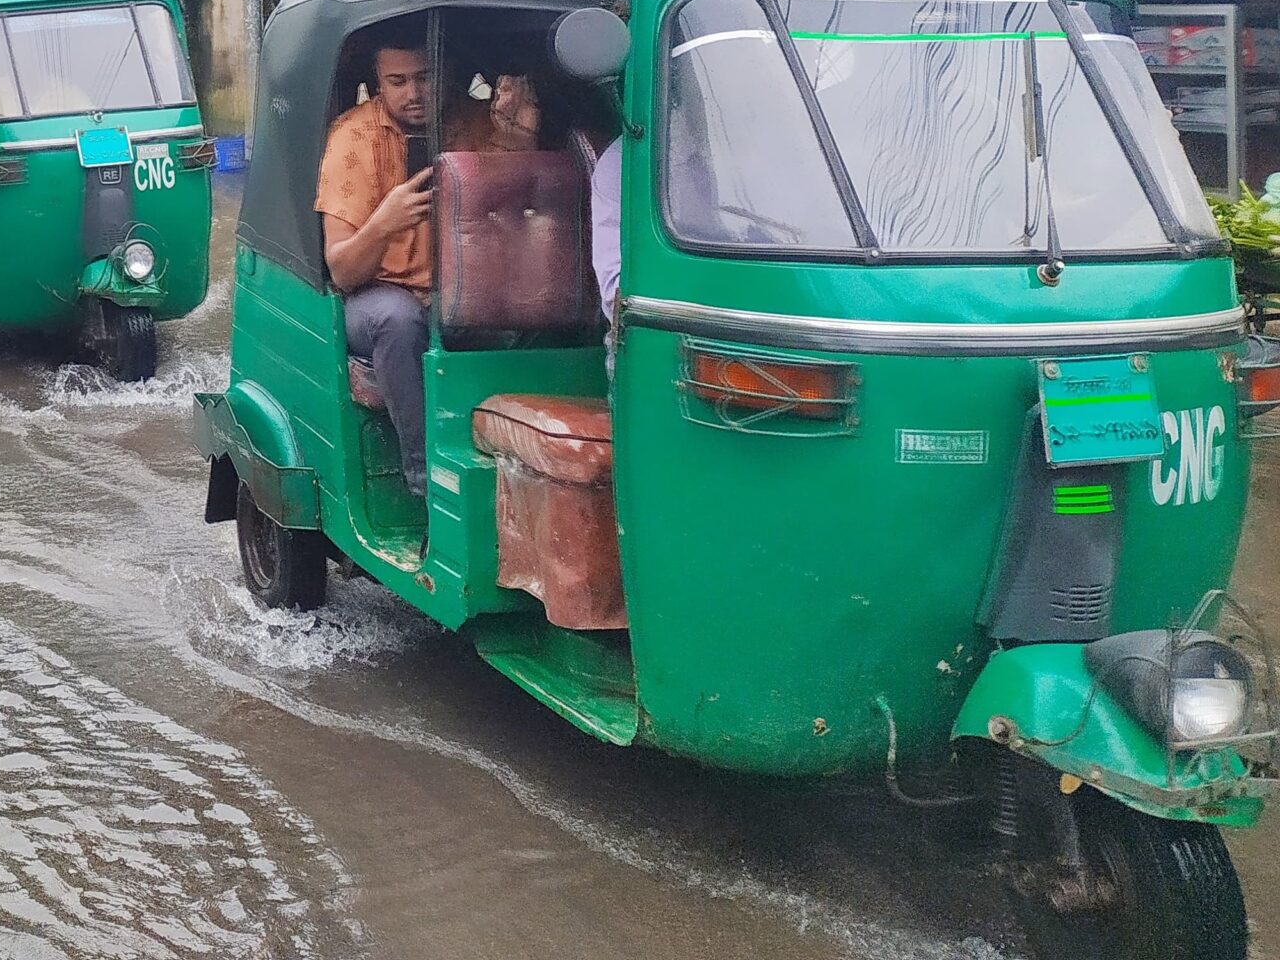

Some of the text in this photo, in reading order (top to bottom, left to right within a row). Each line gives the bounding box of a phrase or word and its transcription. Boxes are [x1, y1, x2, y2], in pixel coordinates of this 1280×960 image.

[103, 170, 119, 180] RE
[134, 156, 176, 191] CNG
[1150, 405, 1226, 506] CNG
